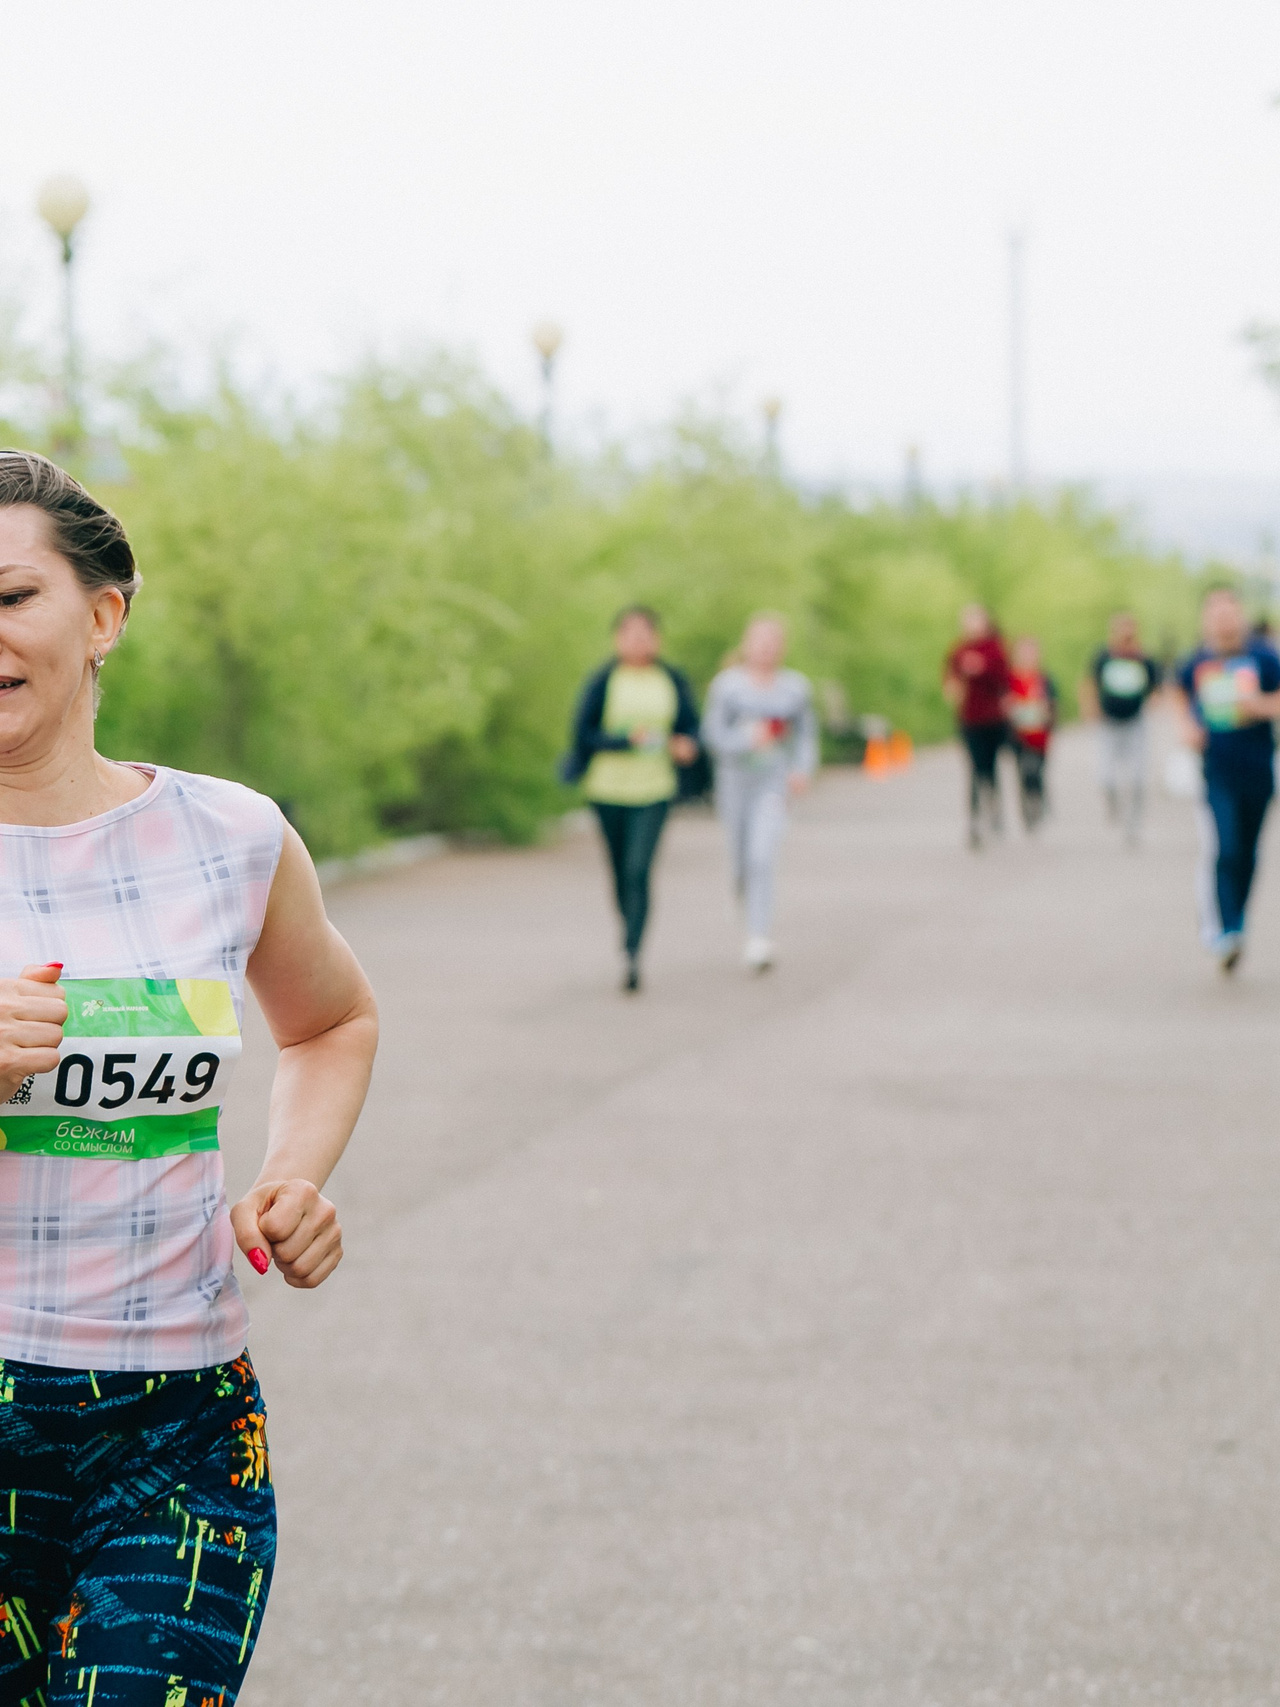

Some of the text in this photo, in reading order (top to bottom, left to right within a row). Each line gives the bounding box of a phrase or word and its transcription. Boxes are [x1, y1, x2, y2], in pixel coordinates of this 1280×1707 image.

[54, 1052, 220, 1109] 0549
[56, 1121, 135, 1143] бежим
[54, 1140, 133, 1154] СО СМЫСЛОМ
